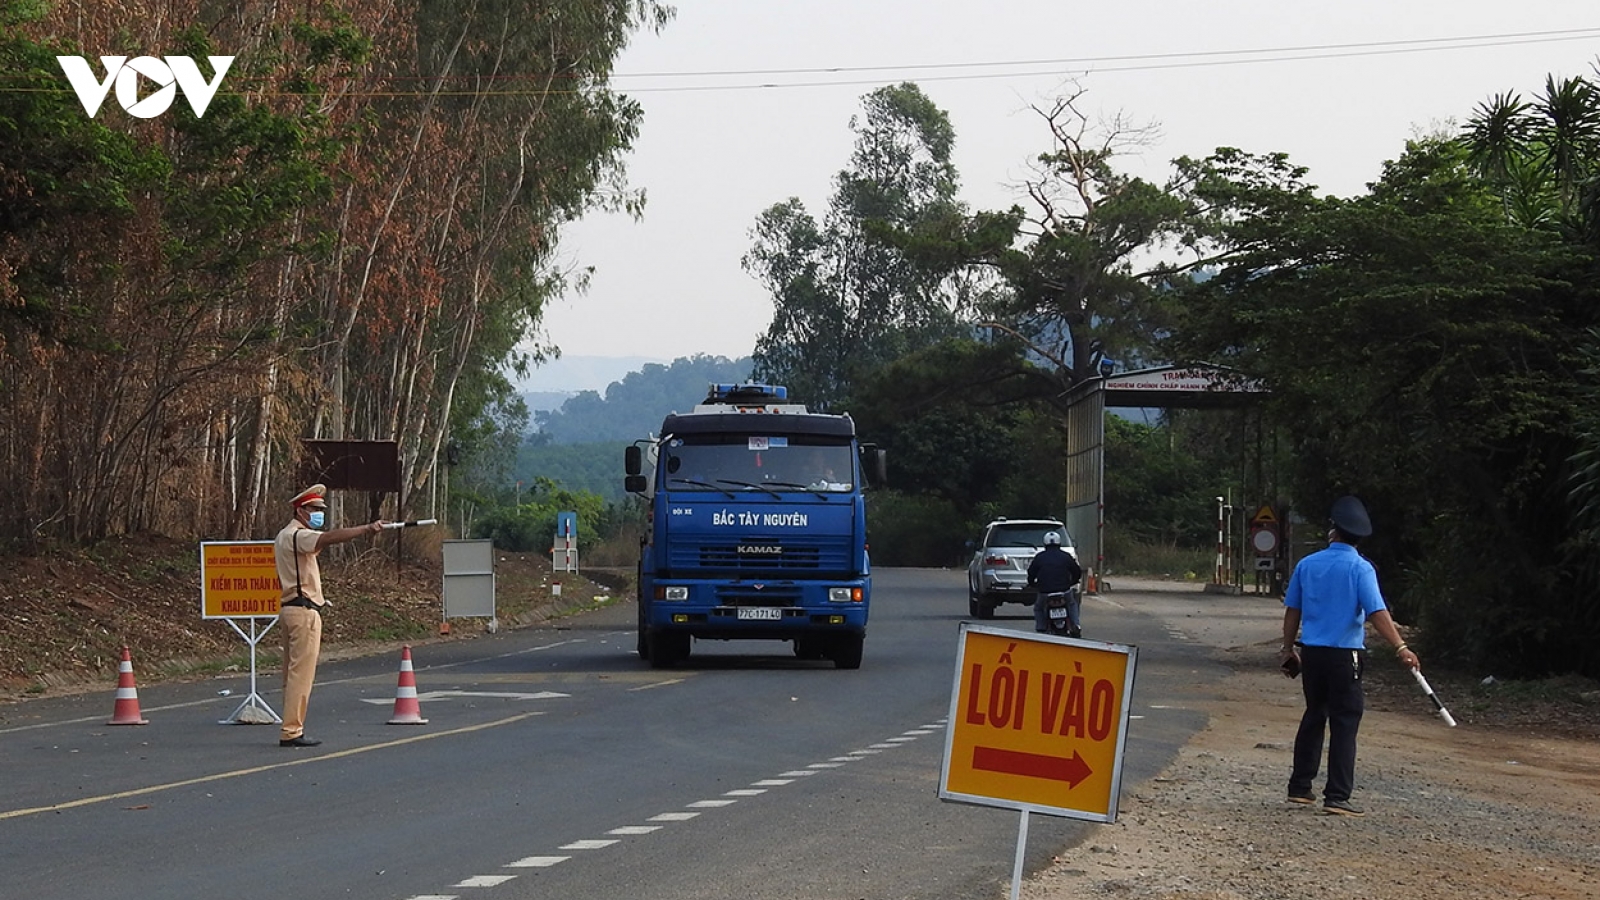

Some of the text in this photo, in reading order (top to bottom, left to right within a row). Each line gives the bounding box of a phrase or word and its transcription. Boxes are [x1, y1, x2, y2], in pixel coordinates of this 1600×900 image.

[713, 509, 807, 527] BẮC TÂY NGUYÊN
[210, 573, 231, 590] KIỂM
[233, 578, 248, 590] TRA
[250, 575, 271, 590] THÂN
[222, 596, 277, 612] KHAI BÁO Y TẾ
[966, 642, 1115, 742] LỐI VÀO
